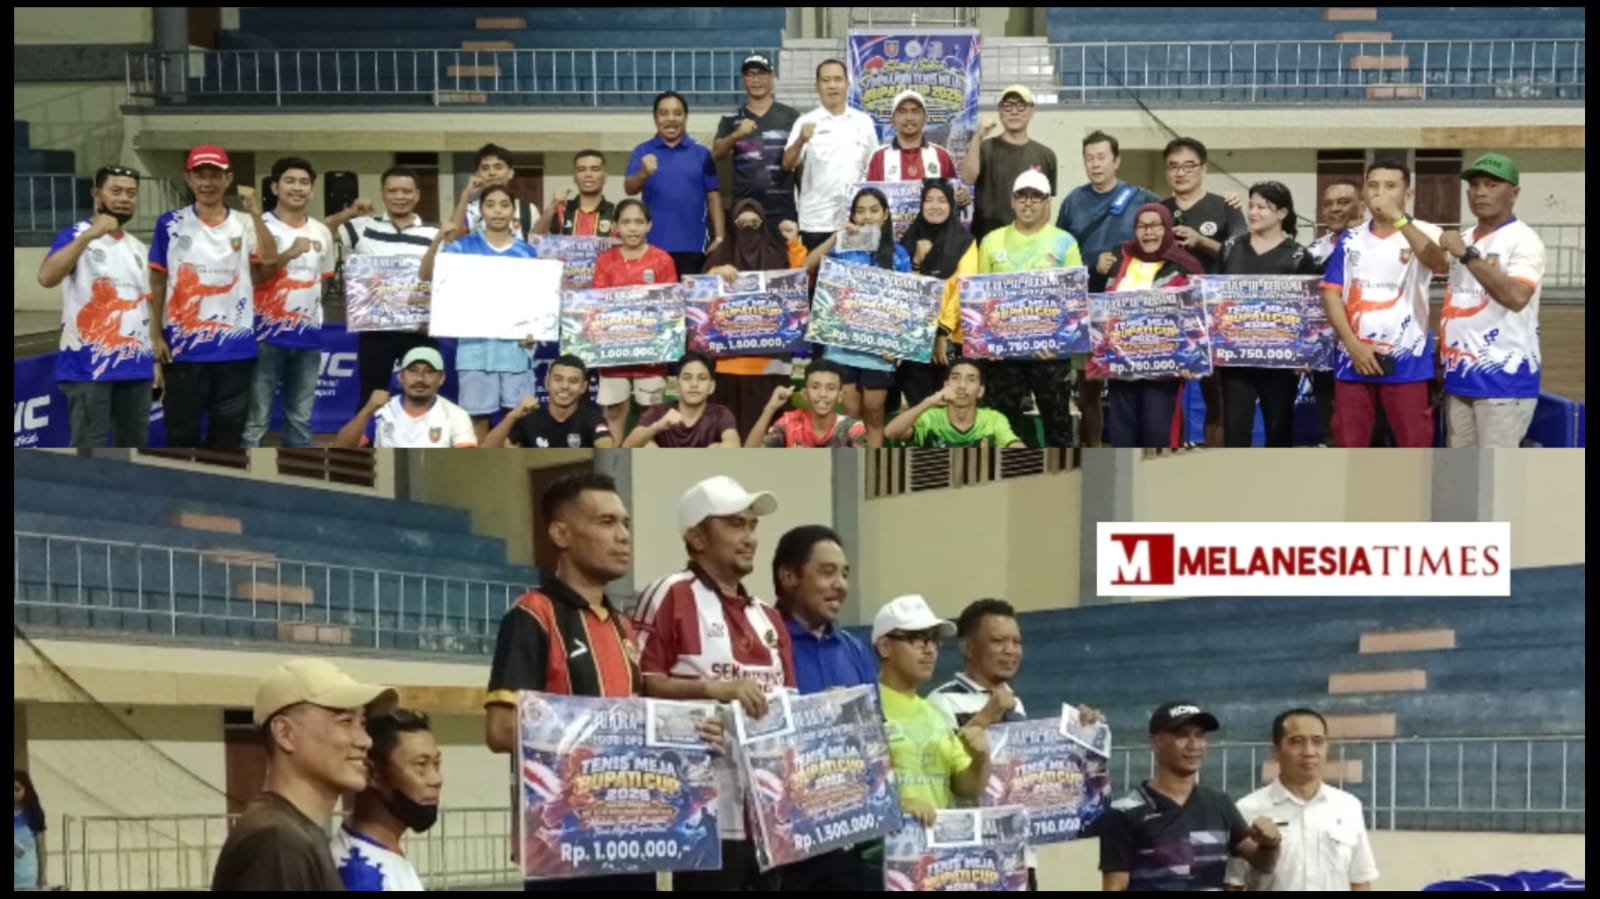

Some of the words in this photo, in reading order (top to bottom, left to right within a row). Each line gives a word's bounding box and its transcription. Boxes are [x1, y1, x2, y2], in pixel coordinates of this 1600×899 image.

[1216, 348, 1238, 362] Rp.
[1240, 348, 1304, 361] 750.000,-
[581, 755, 630, 775] TENIS
[633, 755, 677, 776] MEJA
[573, 771, 640, 795] BUPATI
[641, 772, 682, 796] CUP
[560, 841, 591, 867] Rp.
[593, 839, 691, 862] 1.000.000,-
[793, 832, 816, 853] Rp.
